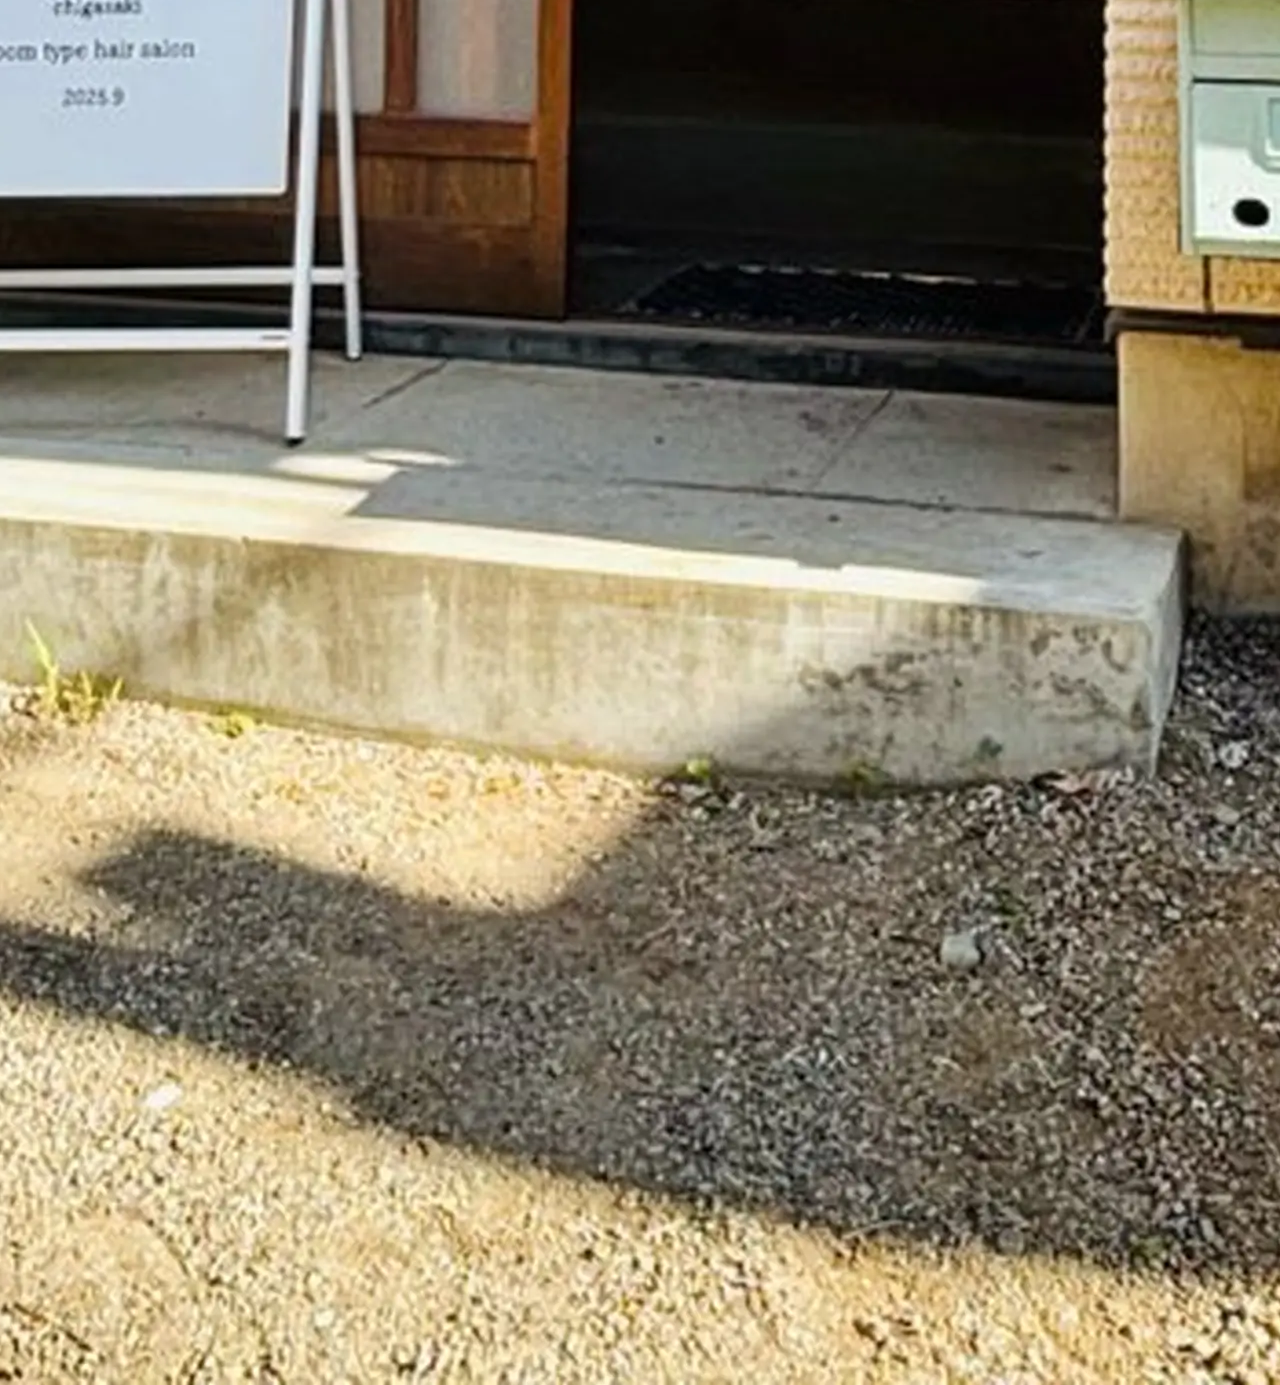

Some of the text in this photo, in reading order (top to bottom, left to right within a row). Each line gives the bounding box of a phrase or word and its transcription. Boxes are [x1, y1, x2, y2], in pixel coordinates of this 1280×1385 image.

[42, 39, 89, 65] type
[93, 38, 135, 59] hair
[140, 38, 196, 59] salon
